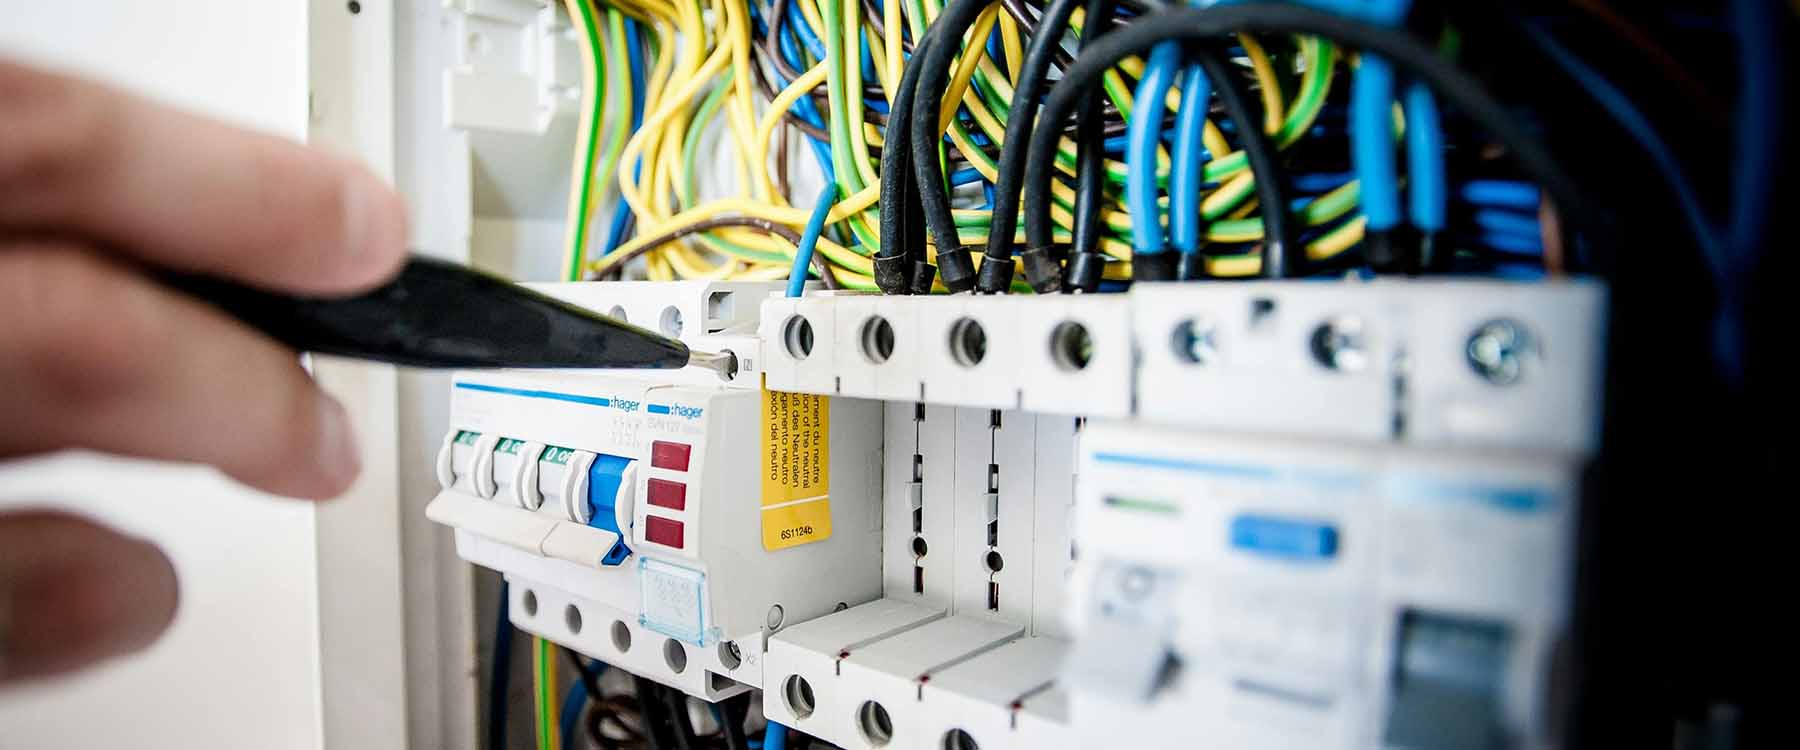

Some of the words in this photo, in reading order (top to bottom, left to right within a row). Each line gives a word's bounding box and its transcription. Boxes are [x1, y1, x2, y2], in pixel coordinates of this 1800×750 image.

[792, 410, 800, 431] des
[802, 416, 810, 427] of
[771, 423, 779, 441] del
[802, 430, 810, 448] the
[813, 431, 821, 446] du
[771, 444, 779, 481] neutro
[792, 434, 801, 488] Neutralen
[802, 451, 811, 489] neutral
[781, 525, 813, 540] 6S1124b
